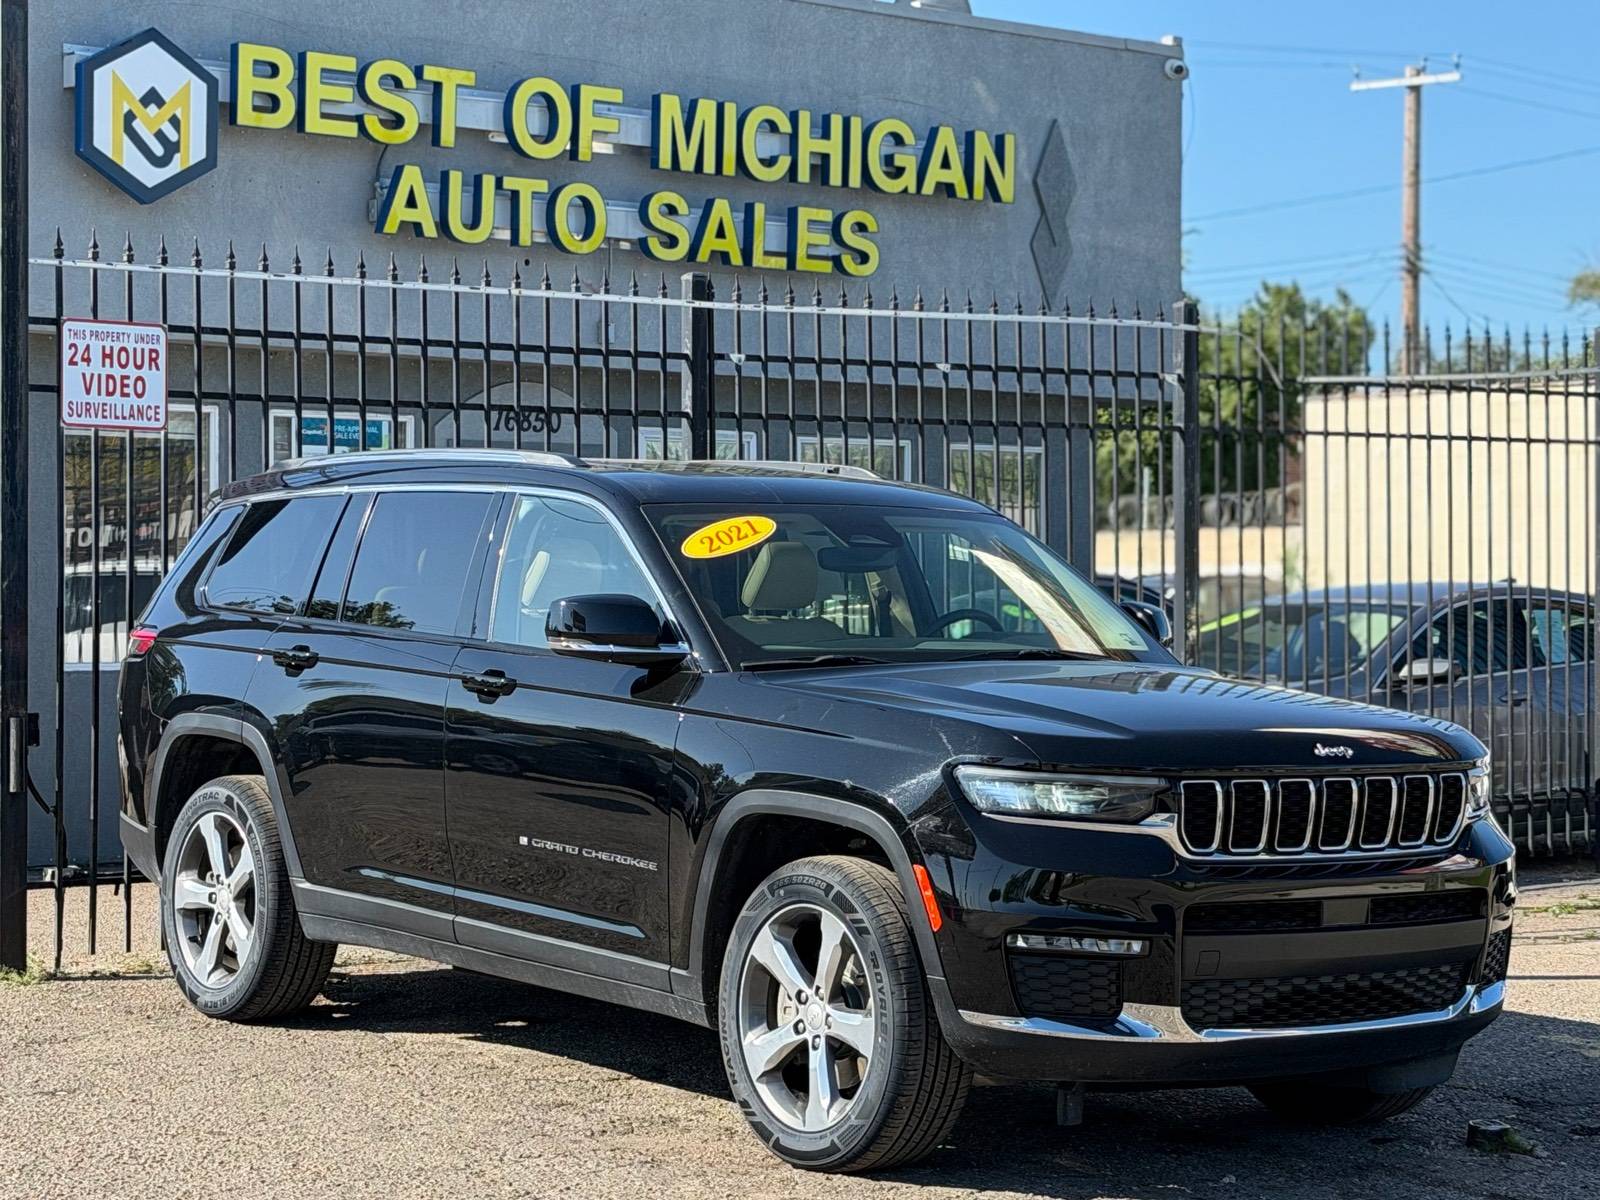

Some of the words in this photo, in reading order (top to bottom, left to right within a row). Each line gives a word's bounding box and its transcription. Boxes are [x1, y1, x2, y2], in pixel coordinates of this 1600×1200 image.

[234, 42, 476, 148] BEST
[508, 76, 624, 162] OF
[654, 92, 1016, 204] MICHIGAN
[380, 164, 608, 255] AUTO
[643, 190, 880, 278] SALES
[67, 328, 87, 341] THIS
[89, 329, 132, 344] PROPERTY
[134, 333, 161, 346] UNDER
[67, 342, 92, 367] 24
[101, 344, 161, 372] HOUR
[81, 371, 147, 399] VIDEO
[67, 400, 161, 423] SURVEILLANCE
[700, 519, 762, 553] 2021
[1313, 742, 1354, 759] Jeep
[531, 838, 579, 855] GRAND
[581, 848, 658, 871] CHEROKEE
